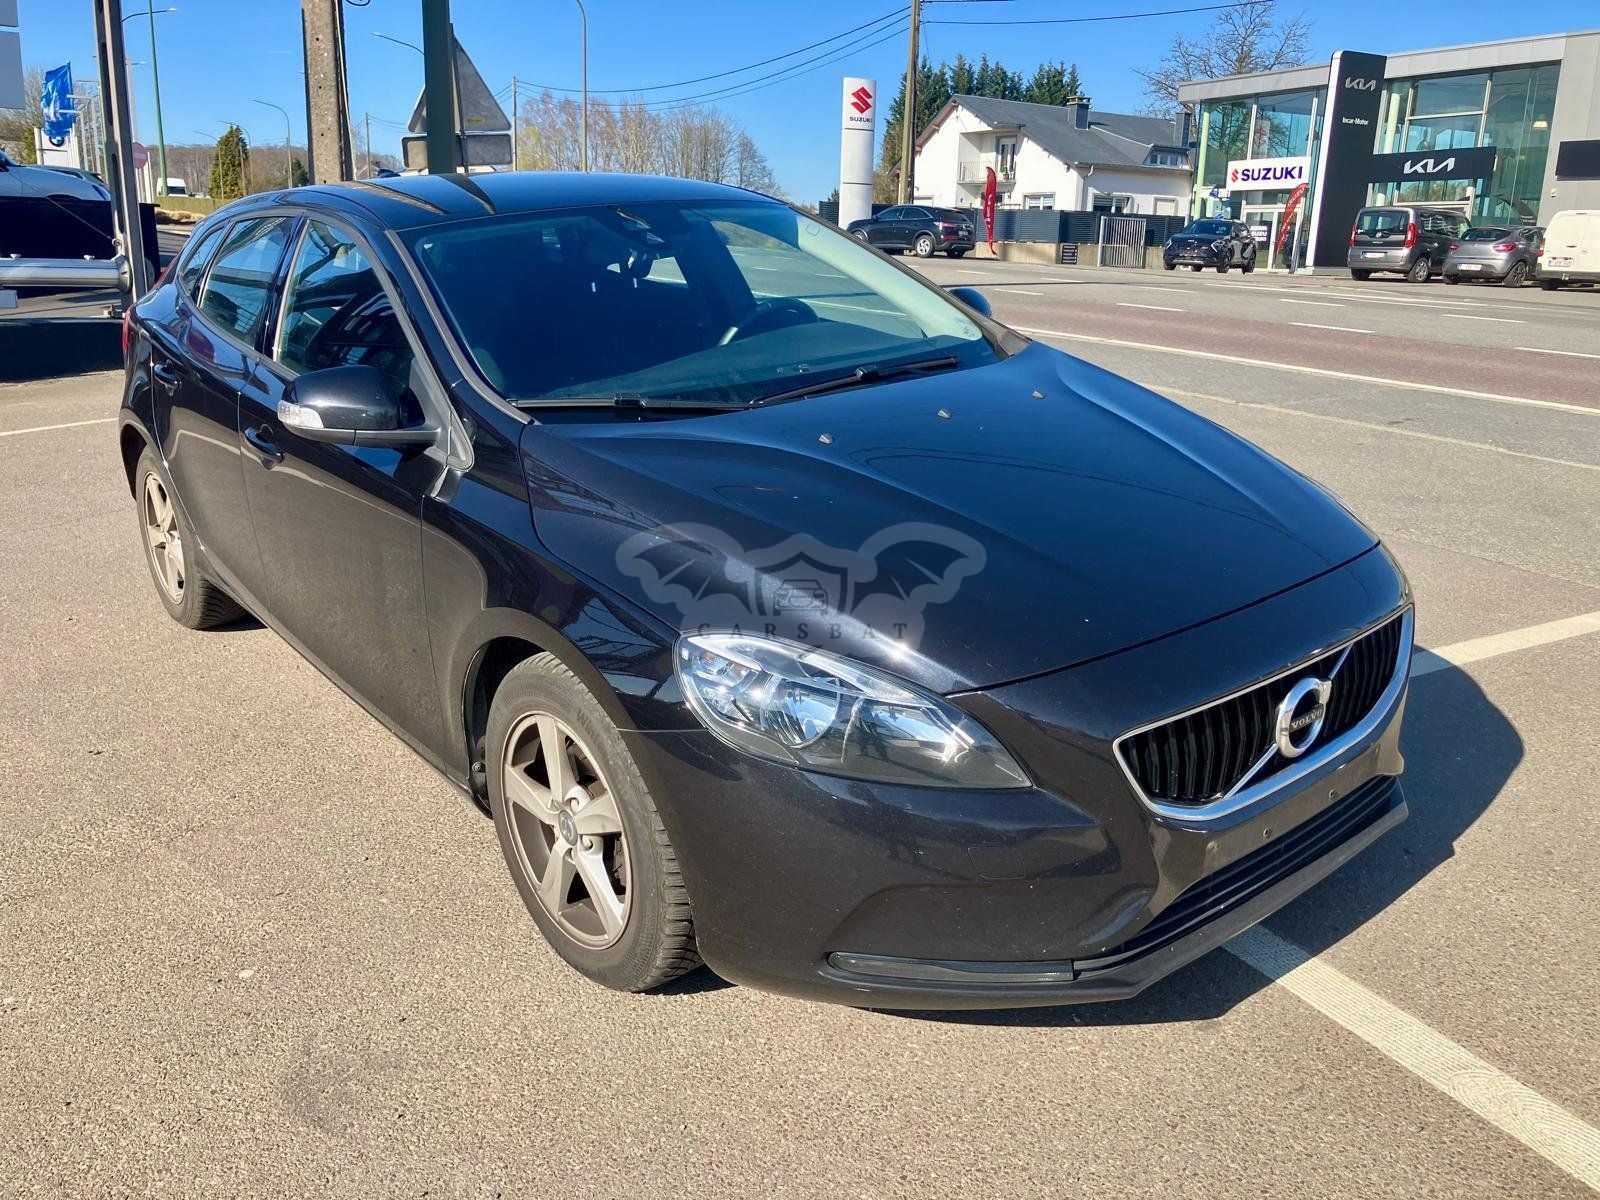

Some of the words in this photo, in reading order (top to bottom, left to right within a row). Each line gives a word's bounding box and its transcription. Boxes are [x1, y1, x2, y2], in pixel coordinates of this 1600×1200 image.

[1241, 166, 1303, 181] SUZUKI
[1403, 157, 1456, 174] KIA
[1290, 709, 1323, 729] VOLVO
